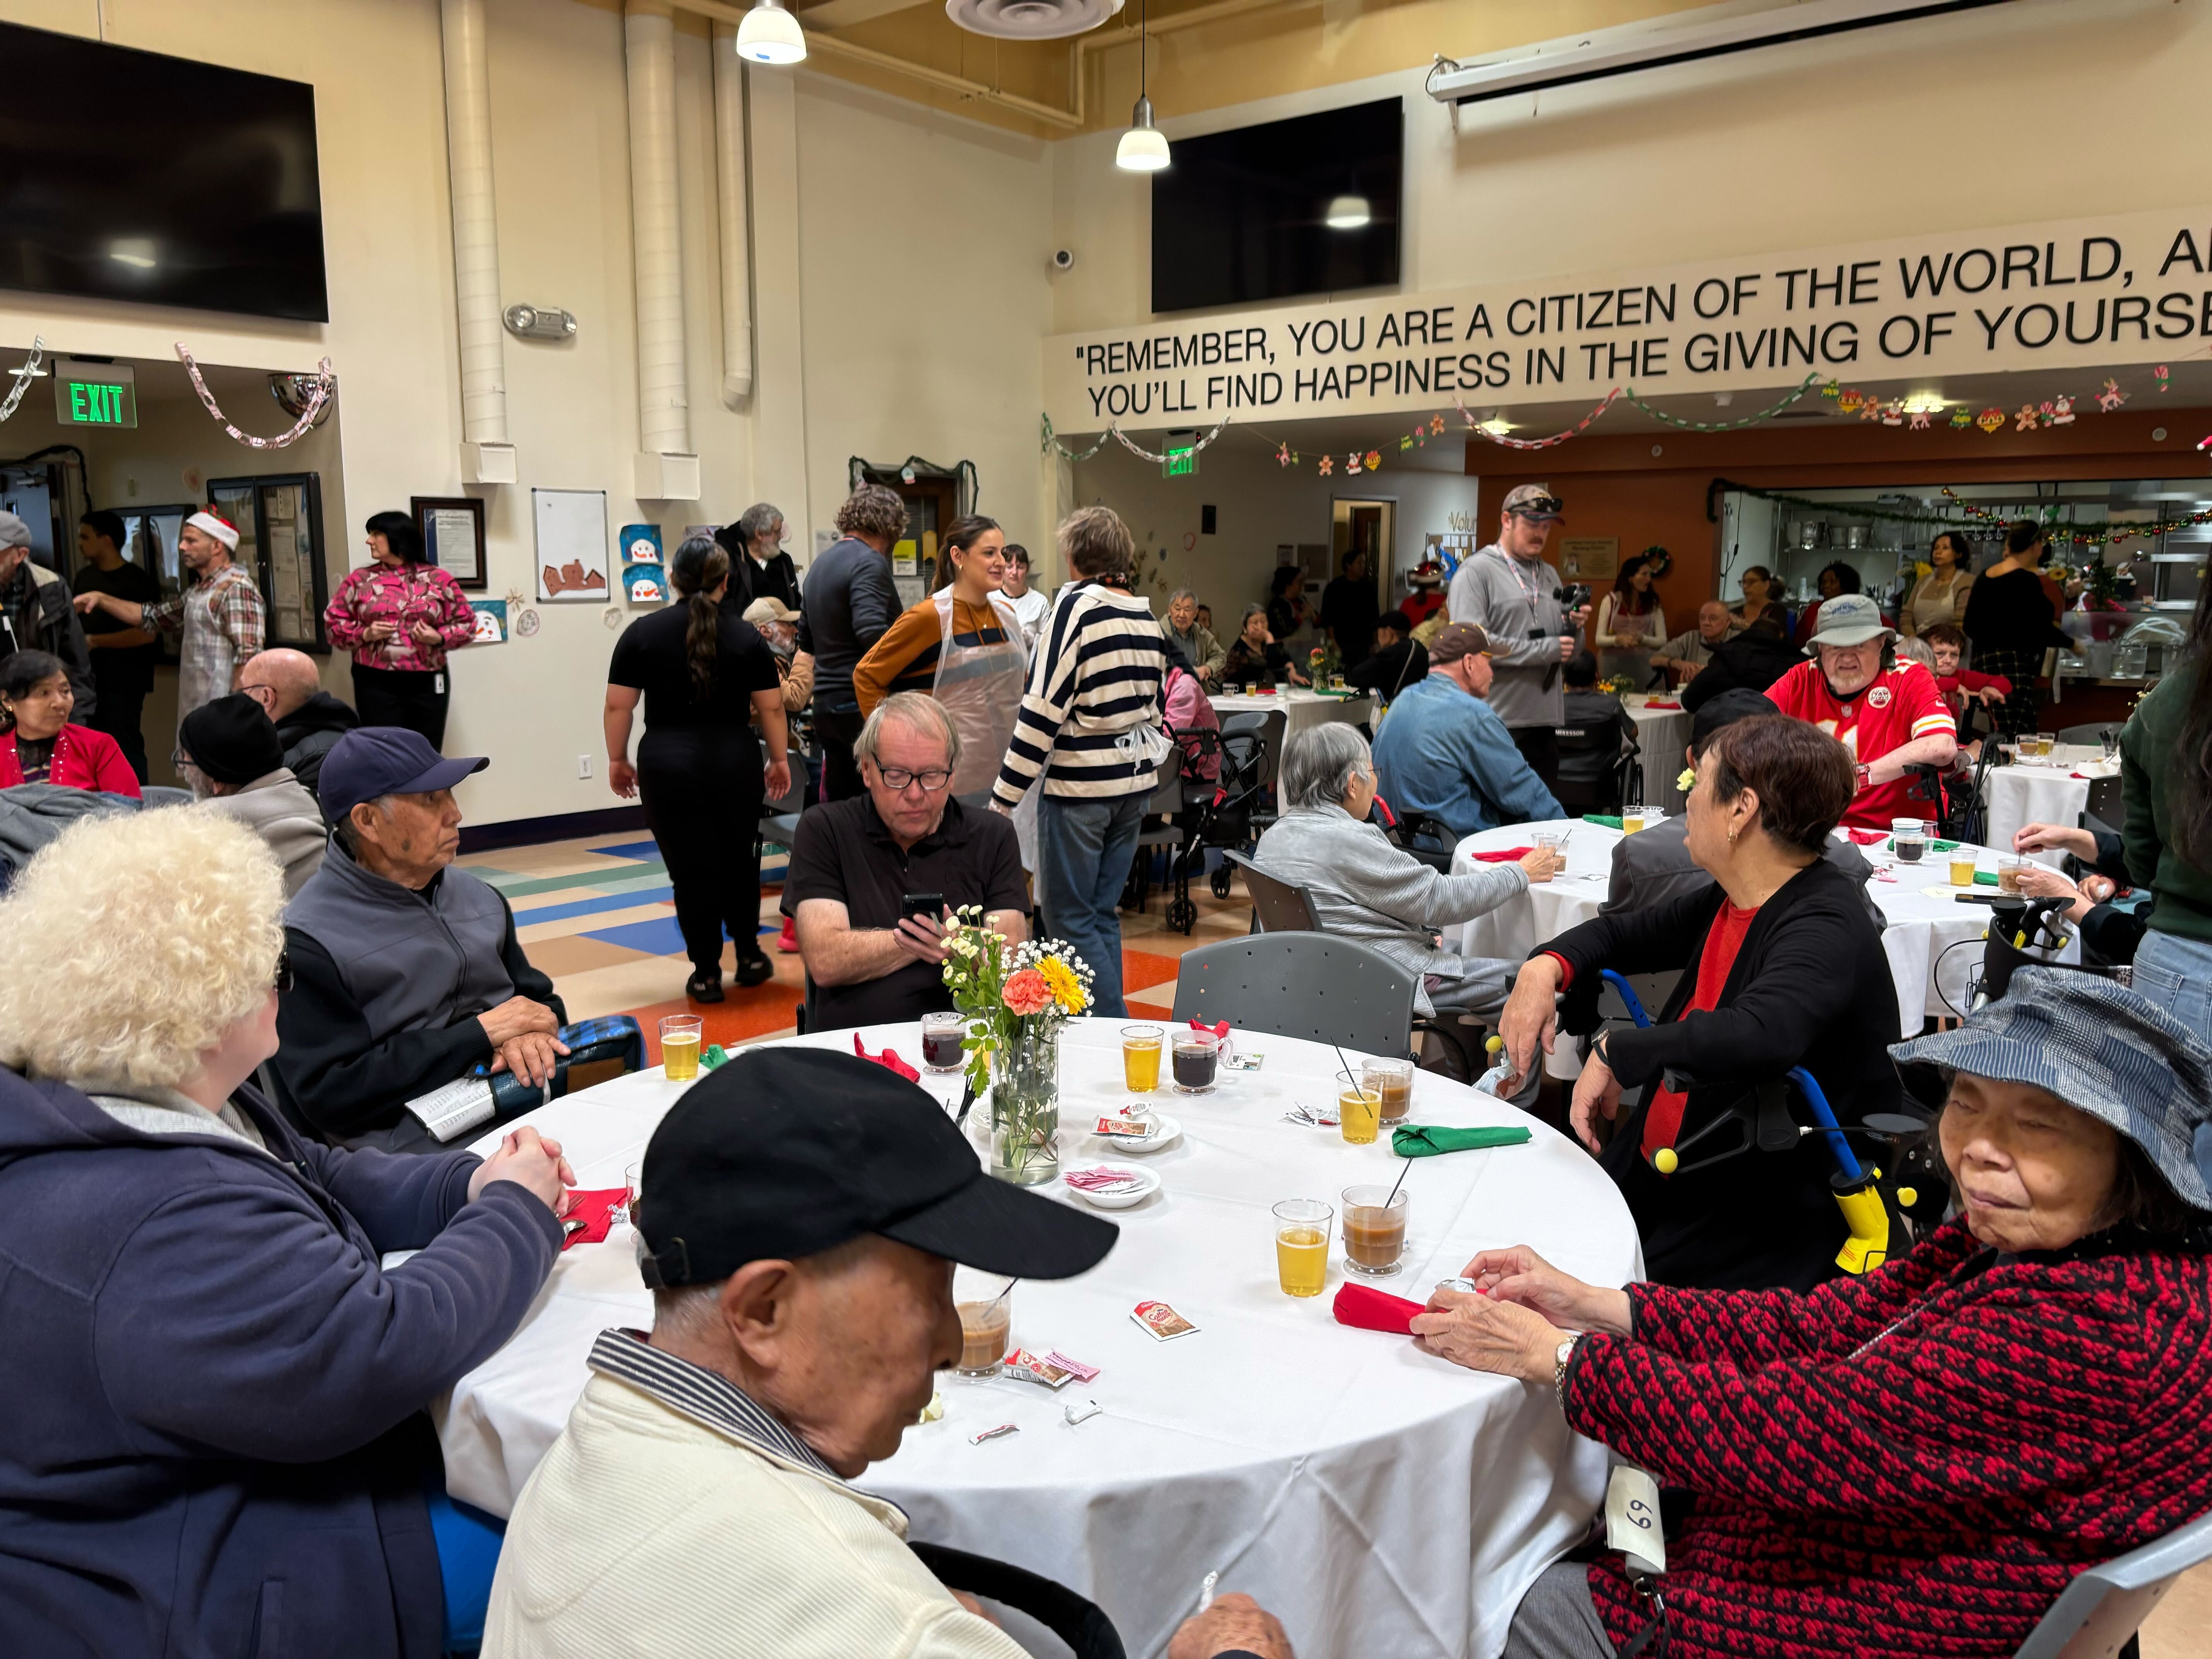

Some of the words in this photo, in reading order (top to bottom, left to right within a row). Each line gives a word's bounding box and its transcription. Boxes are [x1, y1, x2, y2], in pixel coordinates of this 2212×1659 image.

[1077, 328, 1274, 375] "REMEMBER,
[1288, 317, 1364, 356] YOU
[1377, 307, 1454, 348] ARE
[1466, 304, 1492, 340] A
[1507, 284, 1675, 335] CITIZEN
[1694, 275, 1760, 318] OF
[1776, 261, 1880, 310] THE
[1899, 237, 2132, 298] WORLD,
[2159, 229, 2212, 276] A
[1088, 380, 1196, 416] YOU'LL
[1208, 373, 1282, 409] FIND
[1295, 352, 1510, 402] HAPPINESS
[1526, 347, 1564, 385] IN
[1580, 338, 1668, 380] THE
[1685, 322, 1858, 373] GIVING
[1879, 312, 1956, 358] OF
[70, 383, 122, 423] EXIT
[1149, 1309, 1168, 1321] Coffee
[1157, 1312, 1171, 1322] mate
[1626, 1499, 1652, 1530] 69
